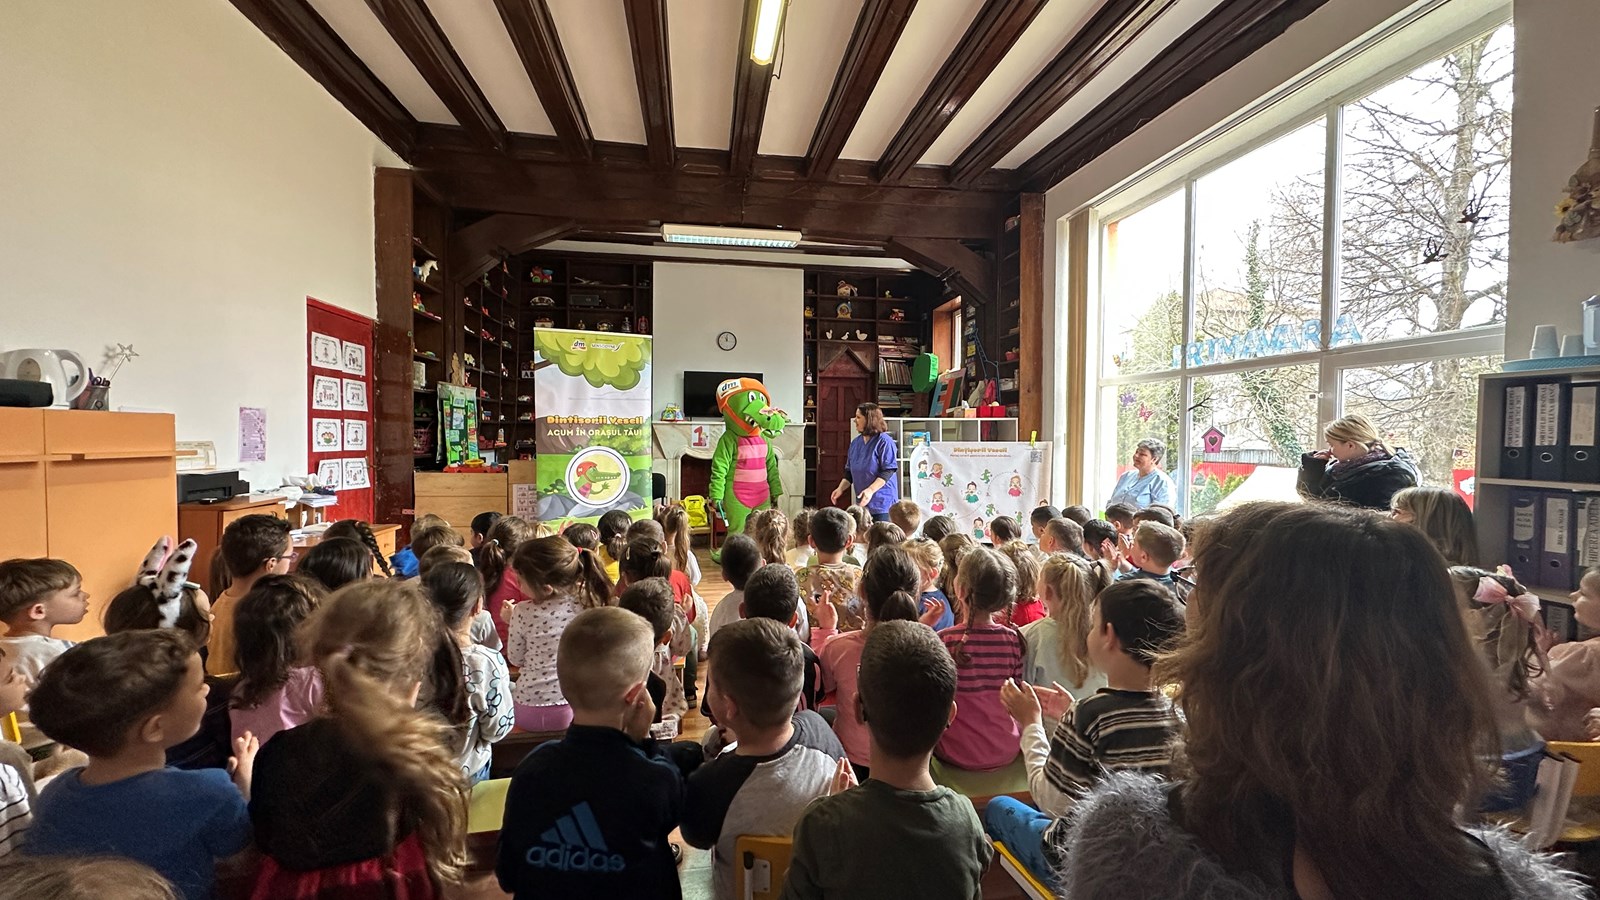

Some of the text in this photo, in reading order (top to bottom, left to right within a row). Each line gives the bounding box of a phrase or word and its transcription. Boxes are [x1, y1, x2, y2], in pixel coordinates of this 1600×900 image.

[721, 382, 737, 392] dm
[608, 415, 643, 425] Veseli
[576, 427, 586, 436] ÎN
[588, 429, 622, 438] ORAȘUL
[694, 426, 707, 447] 1
[526, 843, 626, 872] adidas
